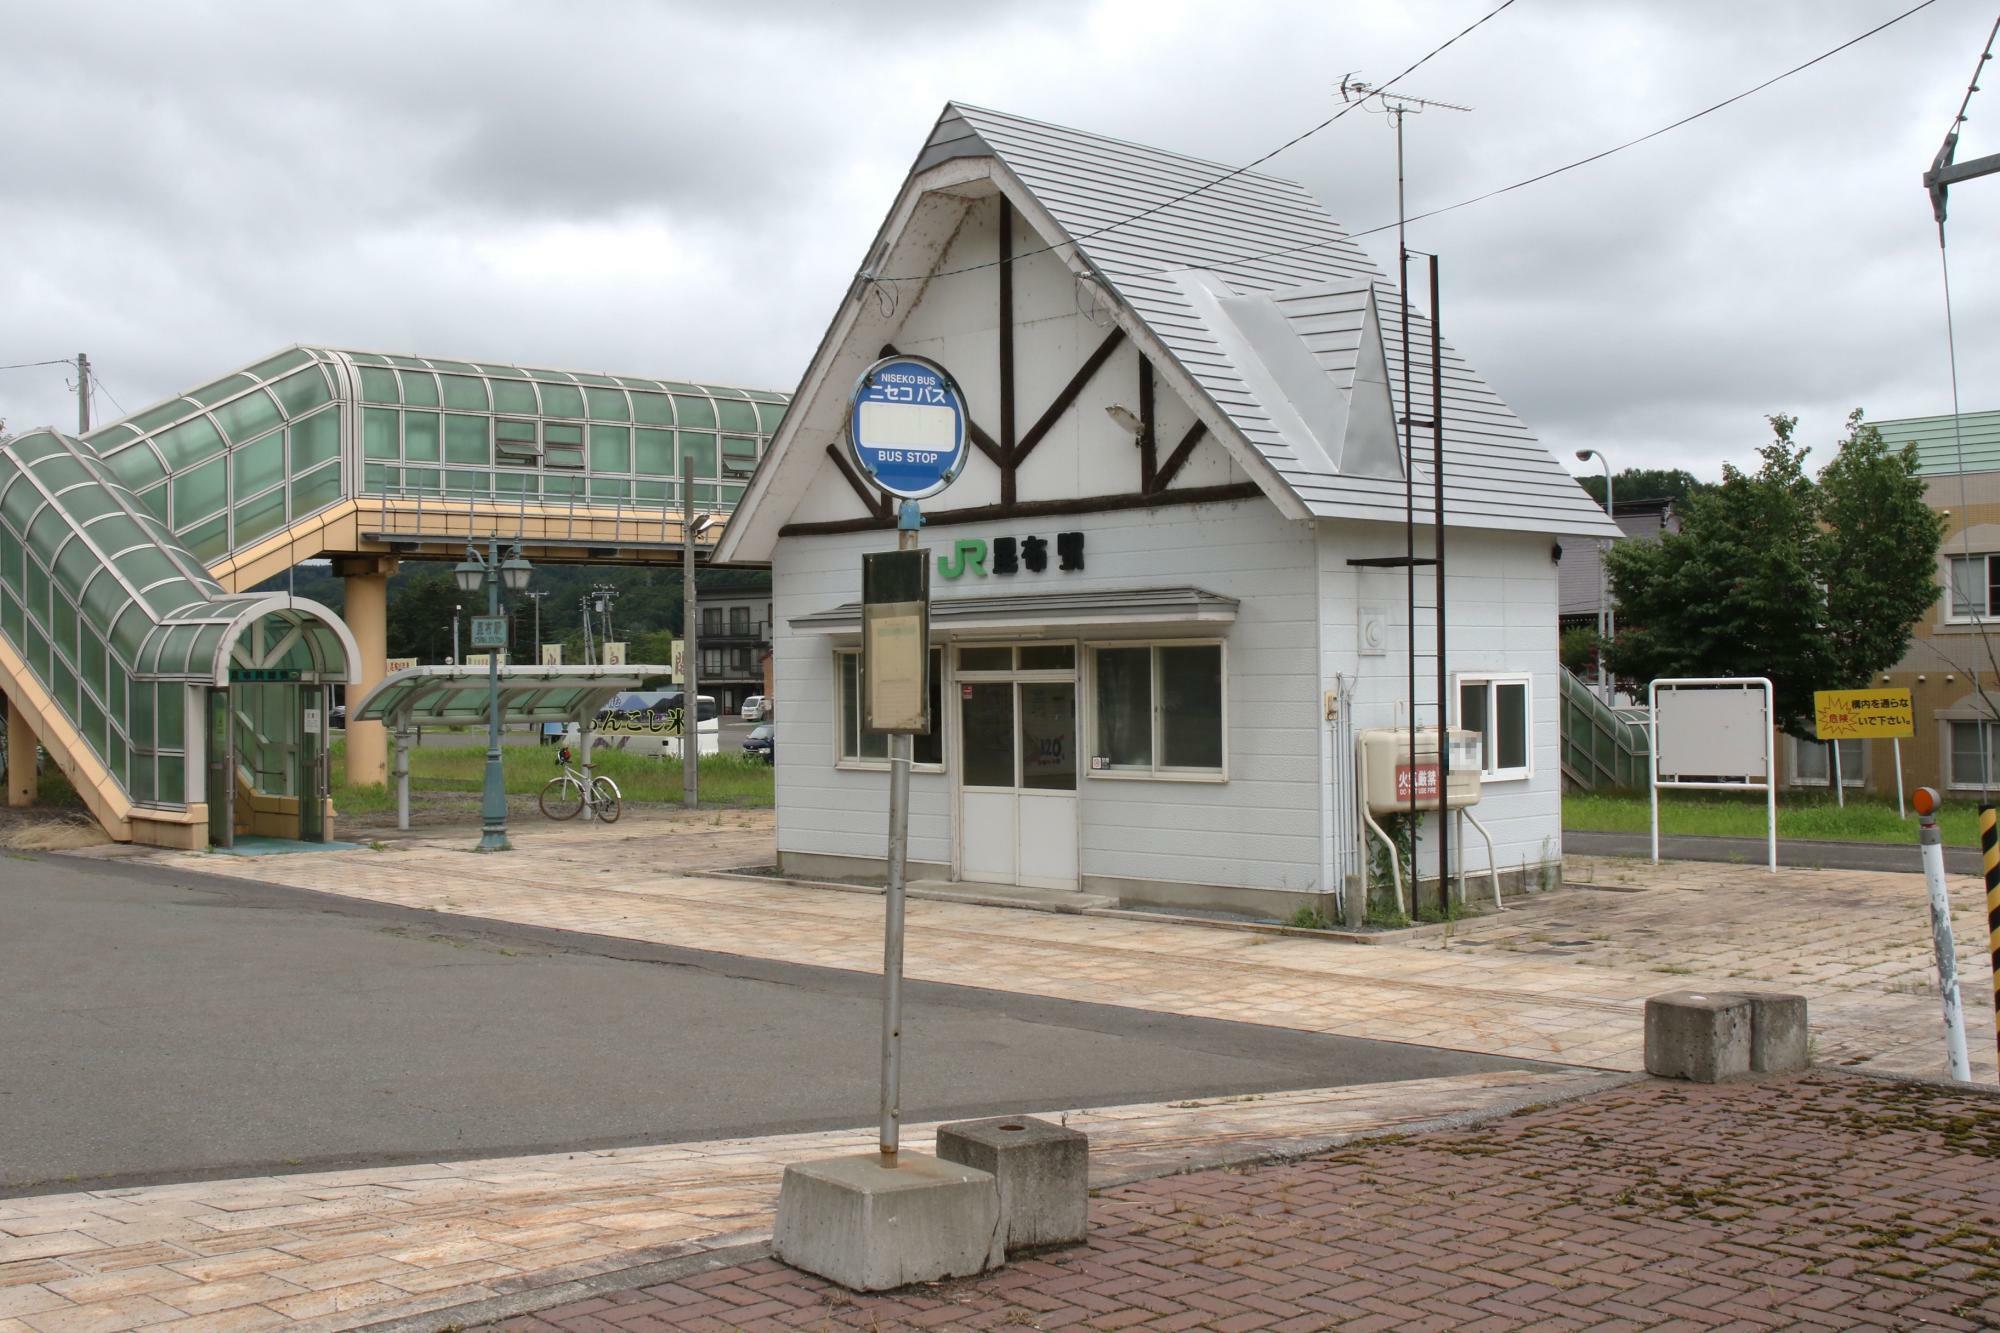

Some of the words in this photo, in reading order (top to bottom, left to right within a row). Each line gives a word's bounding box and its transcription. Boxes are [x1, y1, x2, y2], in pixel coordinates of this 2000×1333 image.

[881, 373, 915, 384] NISEKO
[917, 375, 936, 385] BUS
[878, 450, 903, 462] BUS
[906, 452, 938, 464] STOP
